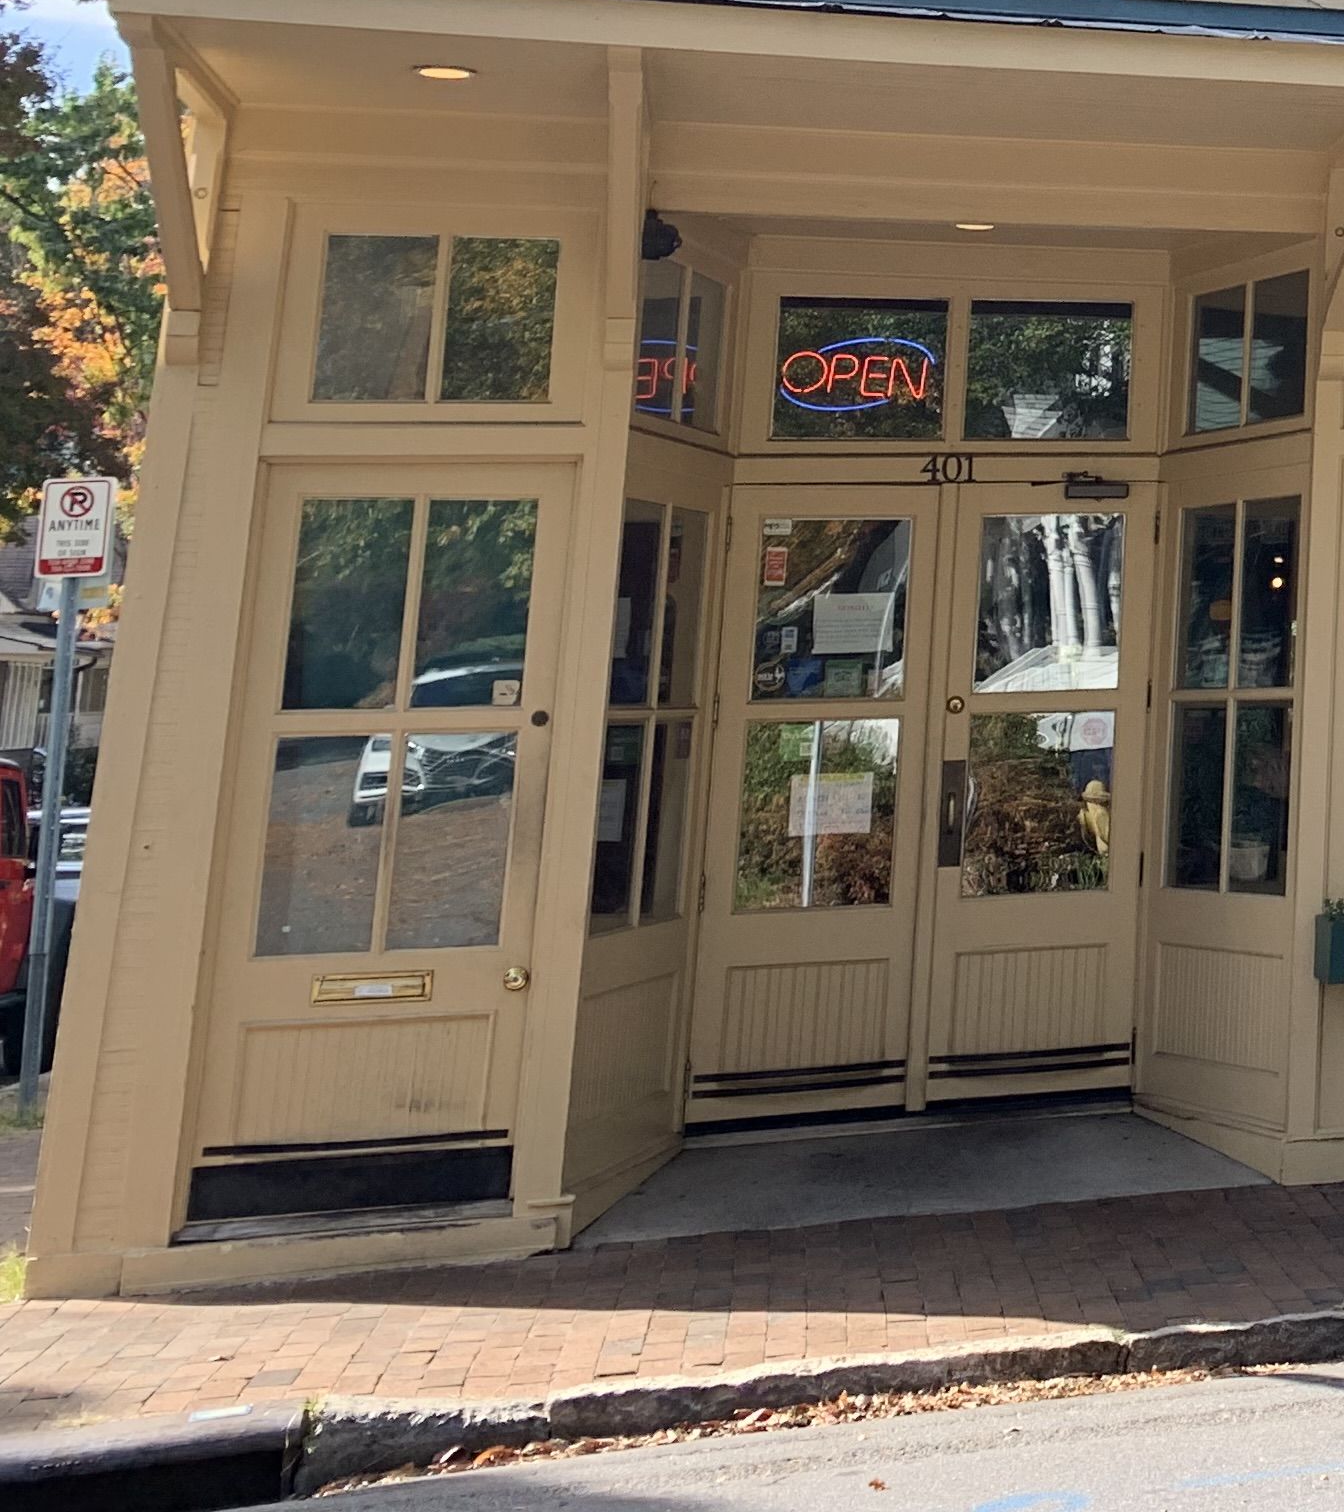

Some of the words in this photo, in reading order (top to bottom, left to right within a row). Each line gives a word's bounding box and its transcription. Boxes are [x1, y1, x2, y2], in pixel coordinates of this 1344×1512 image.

[782, 350, 929, 400] OPEN
[919, 454, 977, 484] 401
[49, 519, 100, 532] ANYTIME
